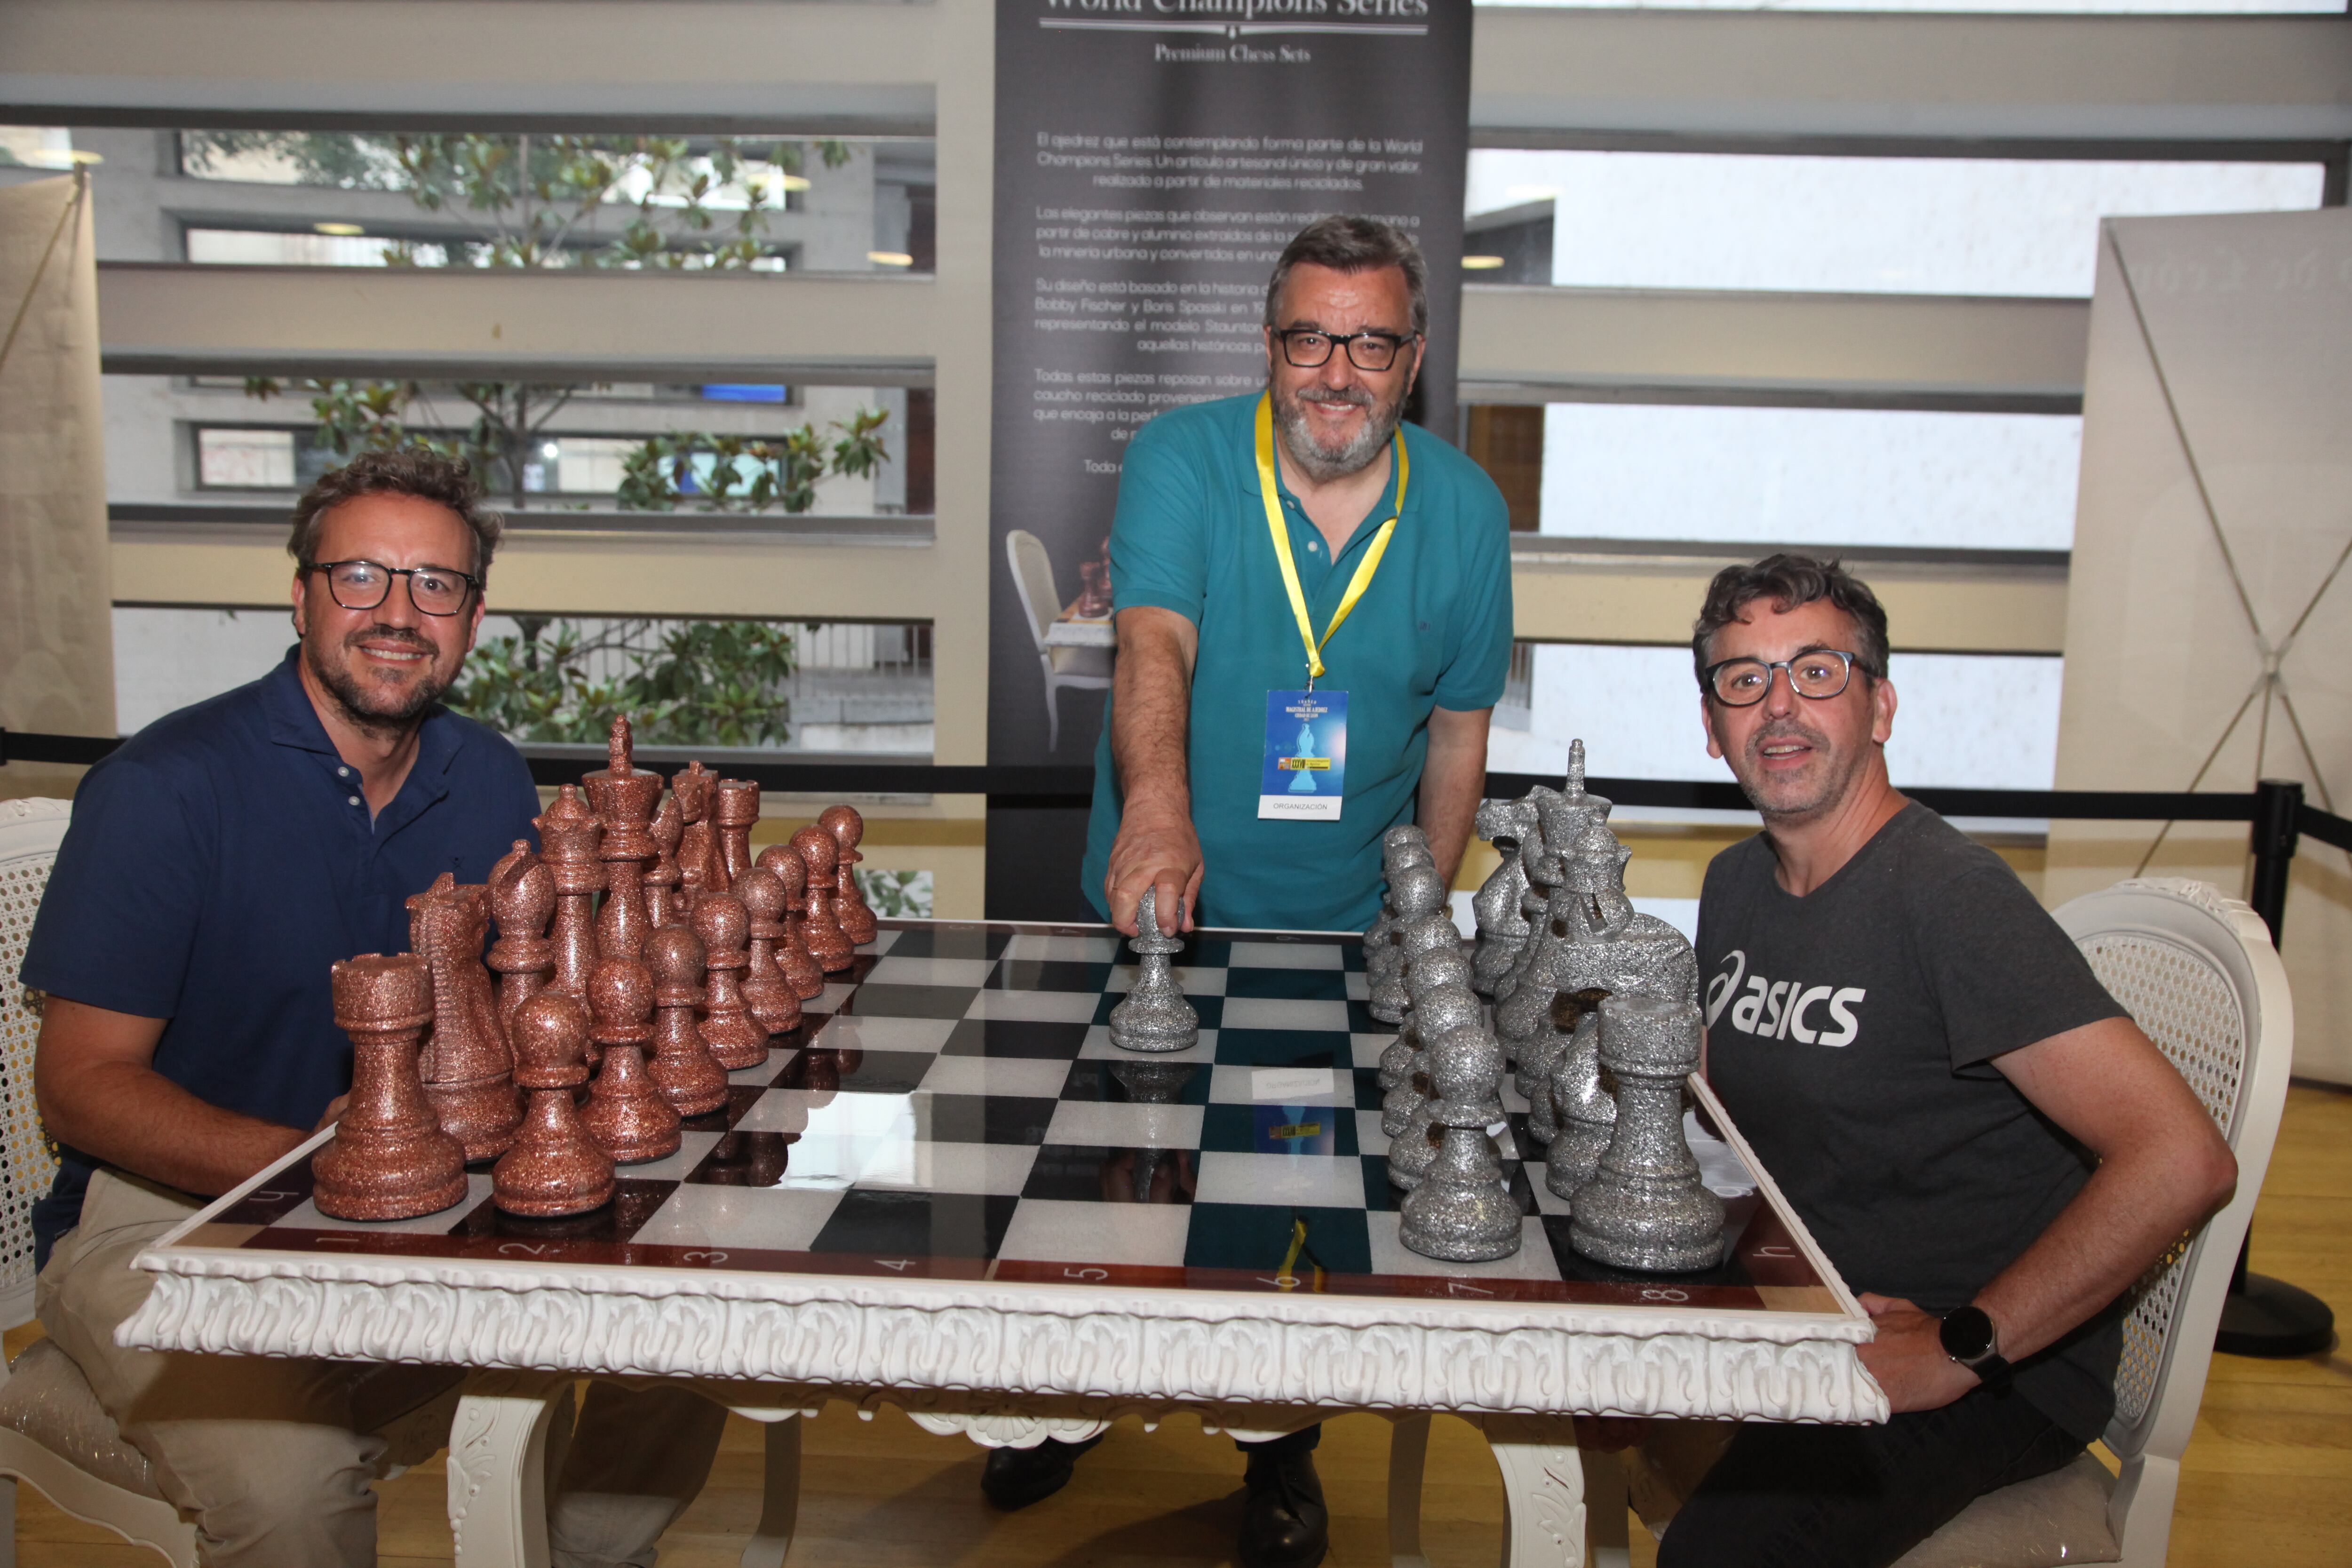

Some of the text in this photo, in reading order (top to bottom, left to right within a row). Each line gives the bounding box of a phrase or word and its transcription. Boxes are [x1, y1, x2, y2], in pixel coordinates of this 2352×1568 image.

[1155, 43, 1311, 63] Premium Chess Sets
[1037, 132, 1049, 147] El
[1050, 134, 1100, 151] ajedrez
[1103, 136, 1128, 151] que
[1163, 135, 1259, 152] contemplando
[1263, 136, 1304, 151] forma
[1306, 138, 1344, 153] parte
[1347, 137, 1366, 153] de
[1368, 138, 1382, 153] la
[1384, 139, 1423, 154] World
[1037, 151, 1111, 170] Champions
[1155, 154, 1174, 169] Un
[1225, 156, 1287, 171] artesanal
[1325, 159, 1335, 173] y
[1336, 156, 1354, 172] de
[1355, 159, 1386, 175] gran
[1093, 173, 1152, 188] realizado
[1154, 176, 1164, 189] a
[1165, 176, 1199, 191] partir
[1203, 174, 1222, 189] de
[1224, 175, 1292, 190] materiales
[1036, 206, 1059, 221] Las
[1061, 207, 1123, 224] elegantes
[1124, 208, 1165, 224] piezas
[1166, 210, 1191, 224] que
[1193, 208, 1253, 223] observan
[1036, 227, 1071, 242] partir
[1073, 226, 1090, 240] de
[1091, 227, 1129, 241] cobre
[1131, 230, 1140, 243] y
[1141, 228, 1193, 242] aluminio
[1255, 229, 1272, 243] de
[1274, 230, 1286, 243] la
[1038, 244, 1051, 258] la
[1102, 246, 1148, 261] urbana
[1150, 249, 1159, 263] y
[1159, 247, 1234, 262] convertidos
[1236, 250, 1254, 262] en
[1036, 278, 1053, 292] Su
[1128, 280, 1178, 295] basado
[1179, 283, 1197, 295] en
[1198, 281, 1211, 295] la
[1211, 281, 1259, 295] historia
[1035, 296, 1077, 314] Bobby
[1081, 297, 1126, 312] Fischer
[1131, 302, 1139, 315] y
[1143, 299, 1175, 314] Boris
[1230, 303, 1248, 314] en
[1035, 318, 1130, 332] representando
[1134, 318, 1146, 332] el
[1150, 318, 1200, 332] modelo
[1137, 338, 1190, 354] aquellas
[1035, 368, 1073, 383] Todas
[1076, 372, 1112, 384] estas
[1115, 372, 1155, 387] piezas
[1159, 374, 1211, 388] reposan
[1215, 373, 1252, 386] sobre
[1033, 388, 1082, 402] caucho
[1086, 390, 1145, 404] reciclado
[1033, 408, 1058, 422] que
[1060, 409, 1104, 424] encaja
[1106, 411, 1116, 422] a
[1117, 408, 1129, 422] la
[1111, 427, 1128, 441] de
[1084, 459, 1117, 474] Toda
[498, 1243, 546, 1255] 2
[683, 1251, 728, 1264] 3
[874, 1259, 916, 1271] 4
[1063, 1268, 1108, 1280] 5
[1256, 1276, 1301, 1287] 6
[1447, 1282, 1494, 1294] 7
[1642, 1289, 1689, 1302] 8
